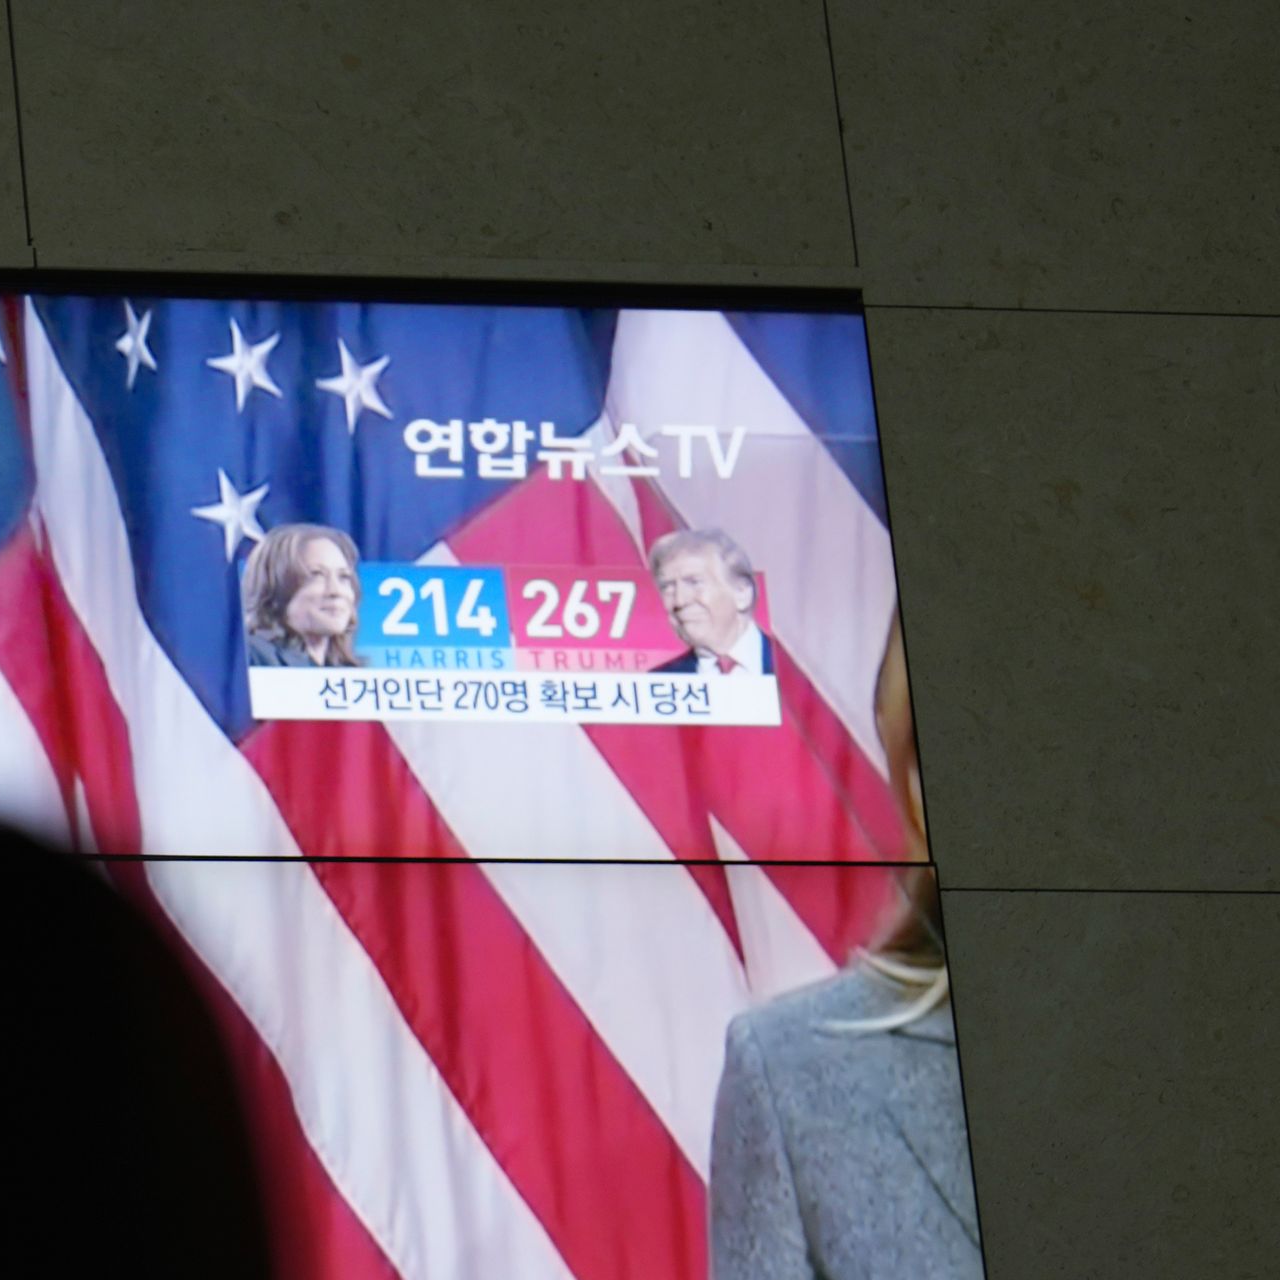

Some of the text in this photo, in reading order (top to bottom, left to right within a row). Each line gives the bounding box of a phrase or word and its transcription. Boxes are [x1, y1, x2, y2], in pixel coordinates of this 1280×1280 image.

[403, 418, 746, 480] 연합뉴스TV
[378, 577, 636, 639] 214 267
[385, 648, 648, 671] HARRIS TRUMP
[318, 679, 711, 715] 선거인단 270명 확보 시 당선
